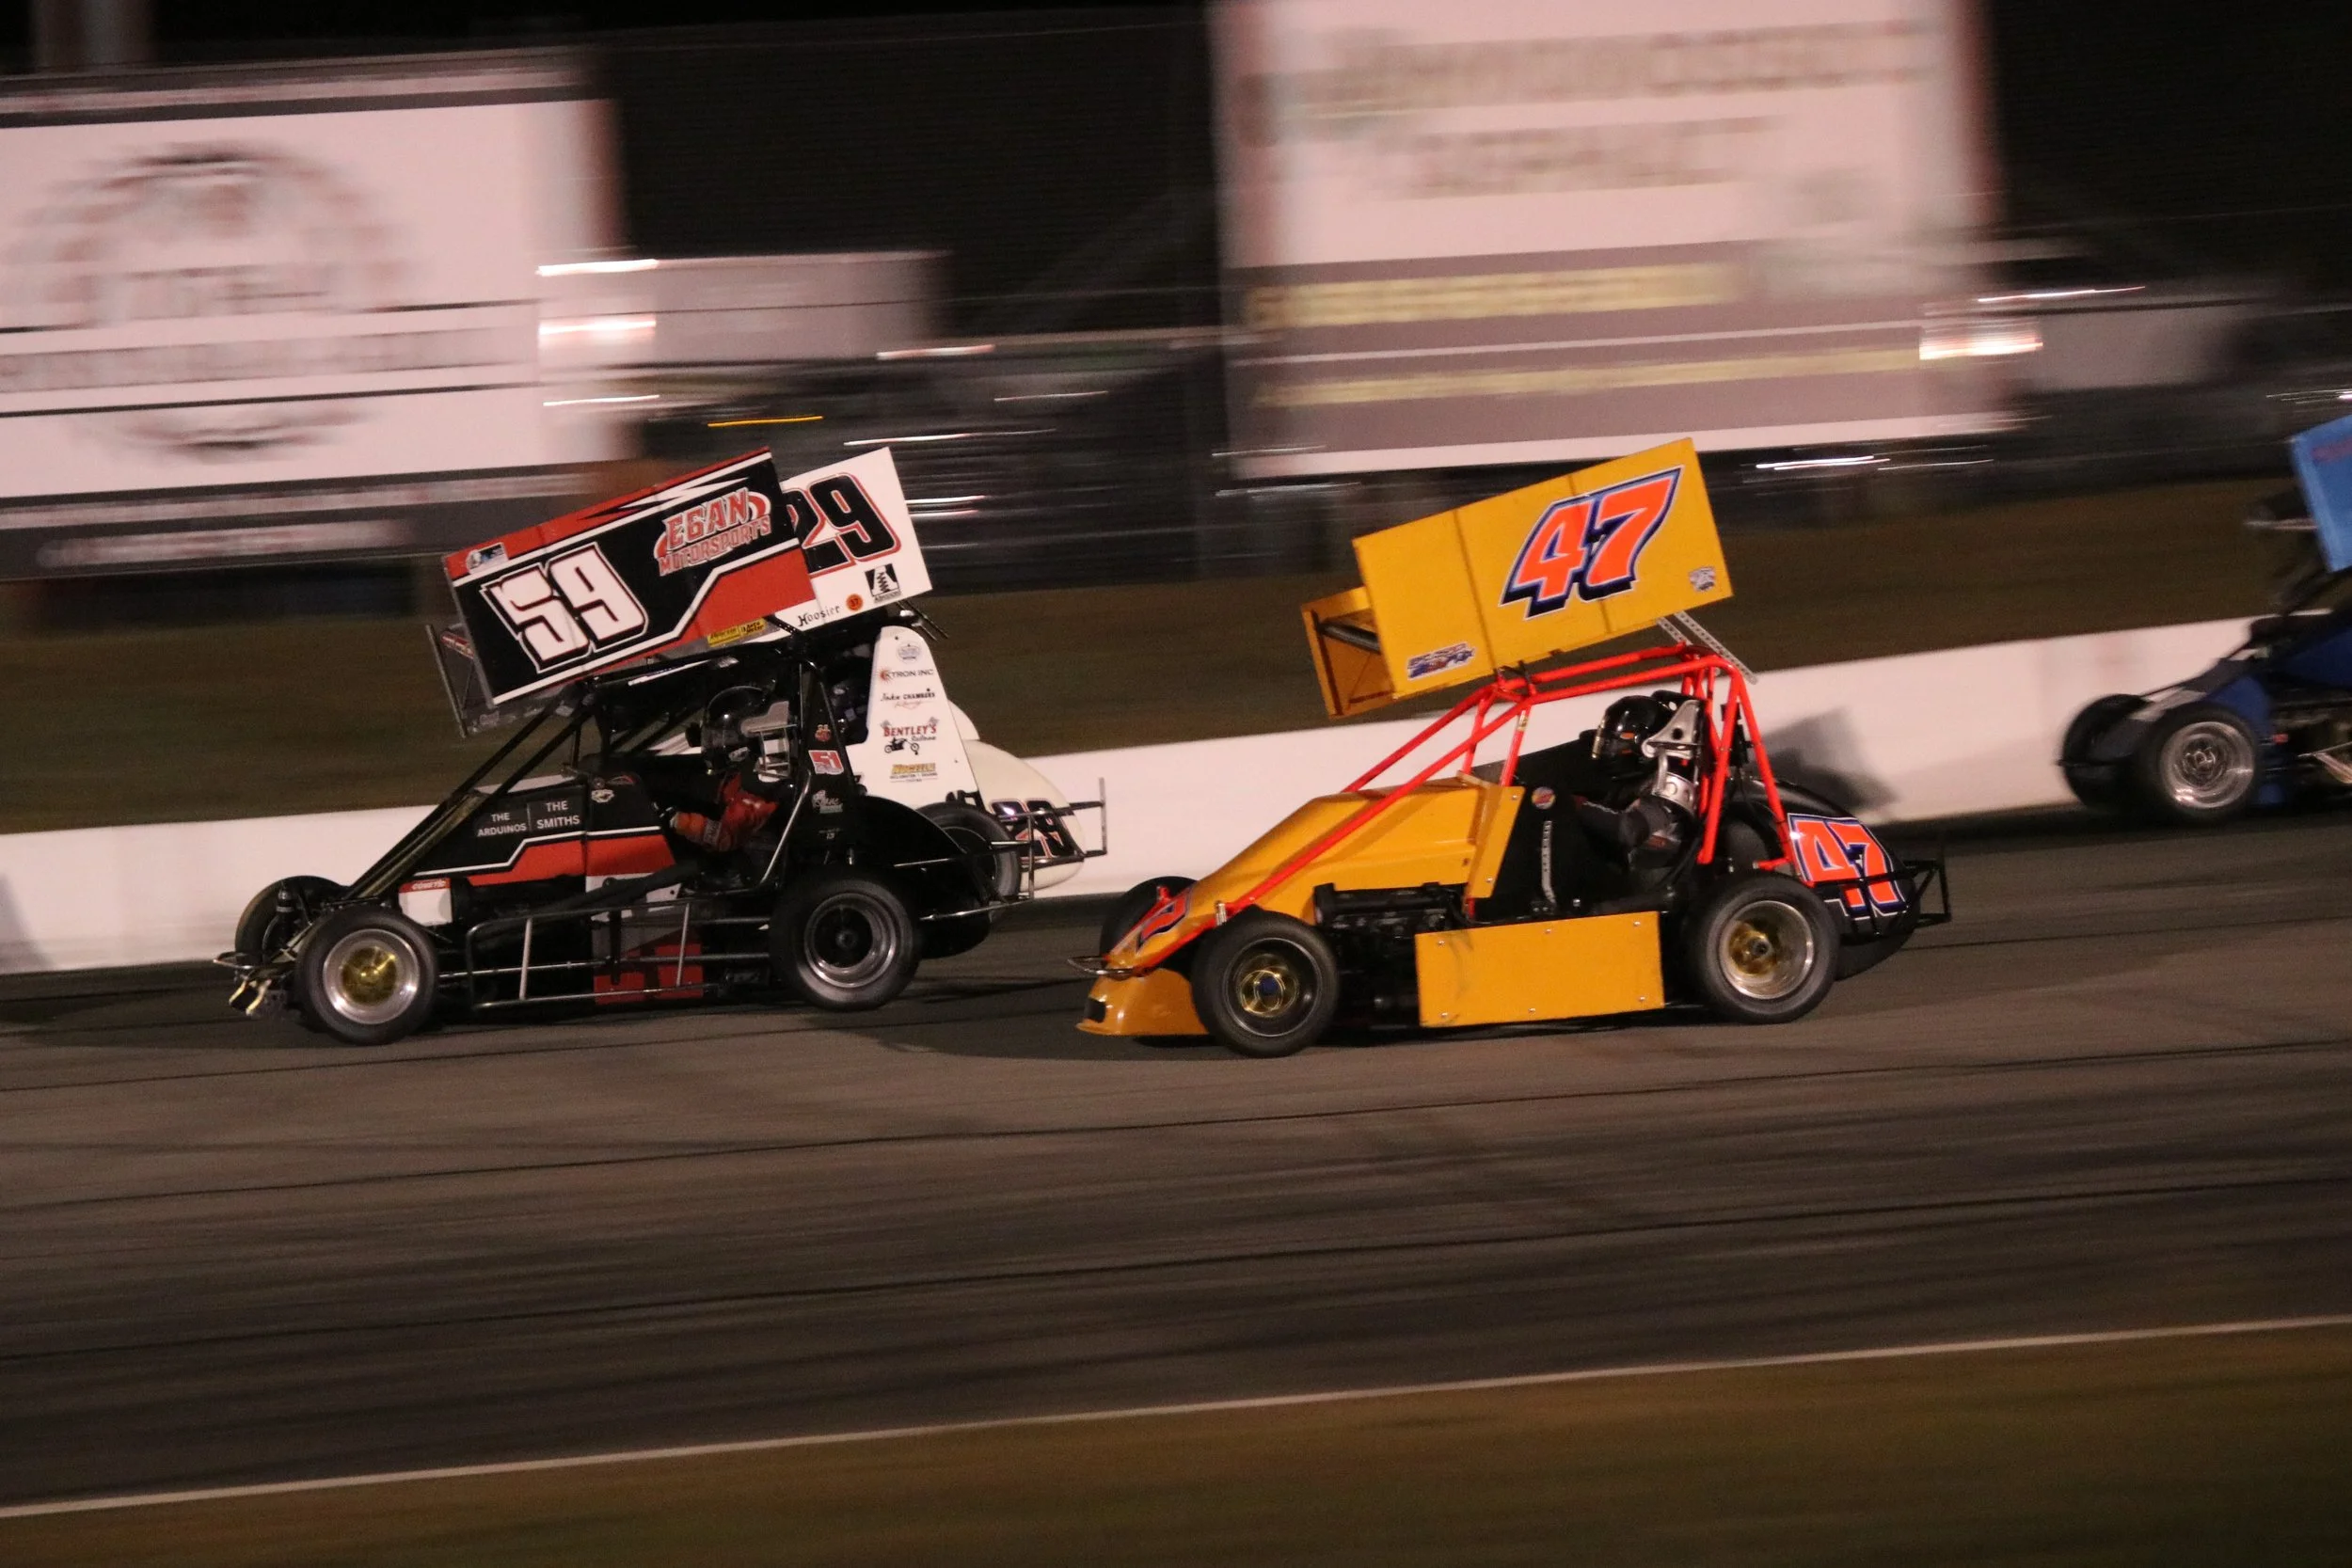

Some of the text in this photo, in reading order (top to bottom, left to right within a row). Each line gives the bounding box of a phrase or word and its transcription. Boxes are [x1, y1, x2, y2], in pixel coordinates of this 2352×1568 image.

[663, 488, 751, 551] EGAN
[659, 515, 771, 577] MOTORSPORTS
[1499, 466, 1684, 619] 47
[480, 543, 647, 672] 59
[798, 605, 841, 627] Hoosier
[882, 723, 937, 737] BENTLEY'S
[490, 812, 511, 821] THE
[546, 800, 568, 812] THE
[477, 823, 527, 836] ARDUINOS
[536, 815, 580, 830] SMITHS
[1787, 813, 1910, 921] 47
